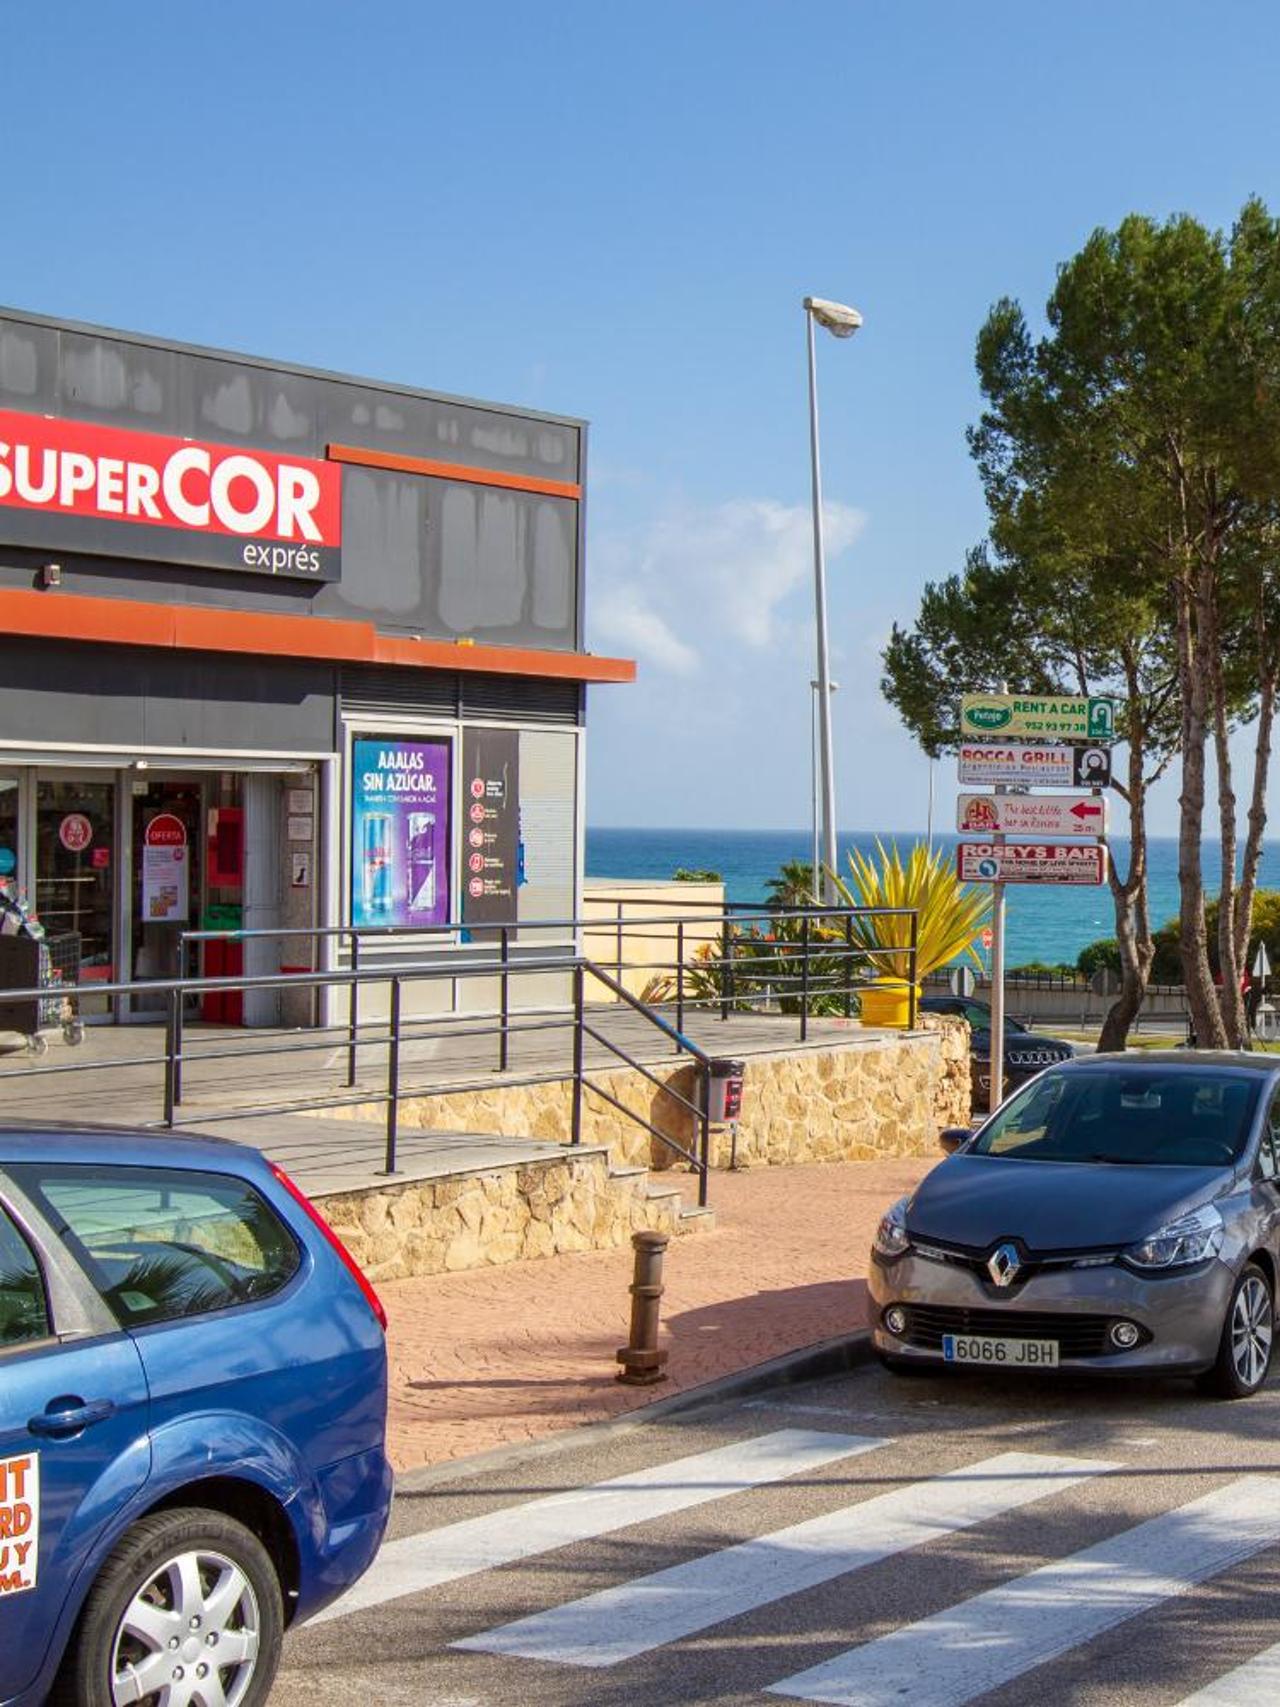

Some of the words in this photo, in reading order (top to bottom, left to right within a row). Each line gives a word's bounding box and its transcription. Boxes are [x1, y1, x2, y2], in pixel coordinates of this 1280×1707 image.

[243, 543, 320, 574] exprés
[1013, 701, 1047, 713] RENT
[1049, 702, 1058, 713] A
[1061, 703, 1086, 715] CAR
[378, 751, 424, 769] AAALAS
[963, 750, 1015, 763] ROCCA
[1022, 751, 1072, 765] GRILL
[363, 772, 383, 791] SIN
[386, 769, 437, 792] AZÚCAR.
[151, 830, 182, 841] OFERTA
[962, 845, 1047, 858] ROSEY'S
[1055, 847, 1098, 859] BAR
[957, 1340, 1006, 1361] 6066
[1015, 1342, 1053, 1363] JBH
